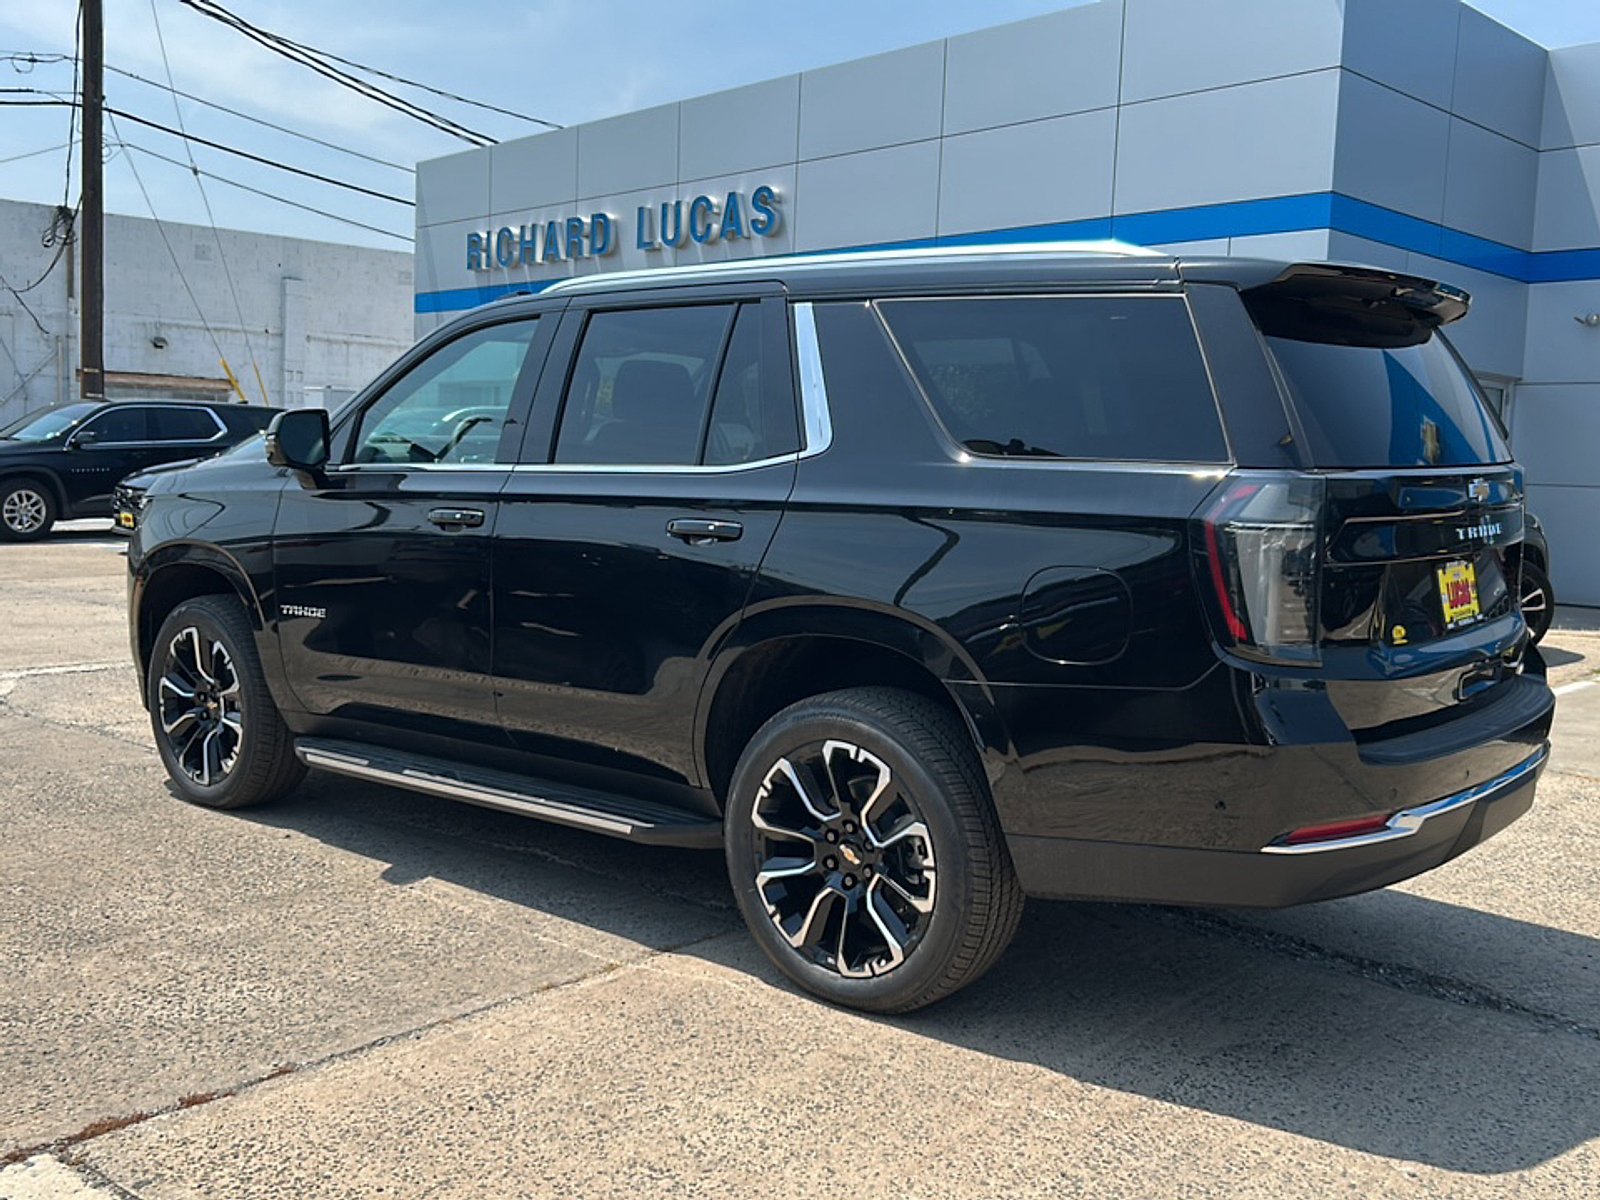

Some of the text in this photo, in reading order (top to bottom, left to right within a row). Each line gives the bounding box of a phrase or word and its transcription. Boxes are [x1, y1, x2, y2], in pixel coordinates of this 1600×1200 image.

[466, 184, 780, 272] RICHARD LUCAS
[280, 604, 327, 618] TAHOE
